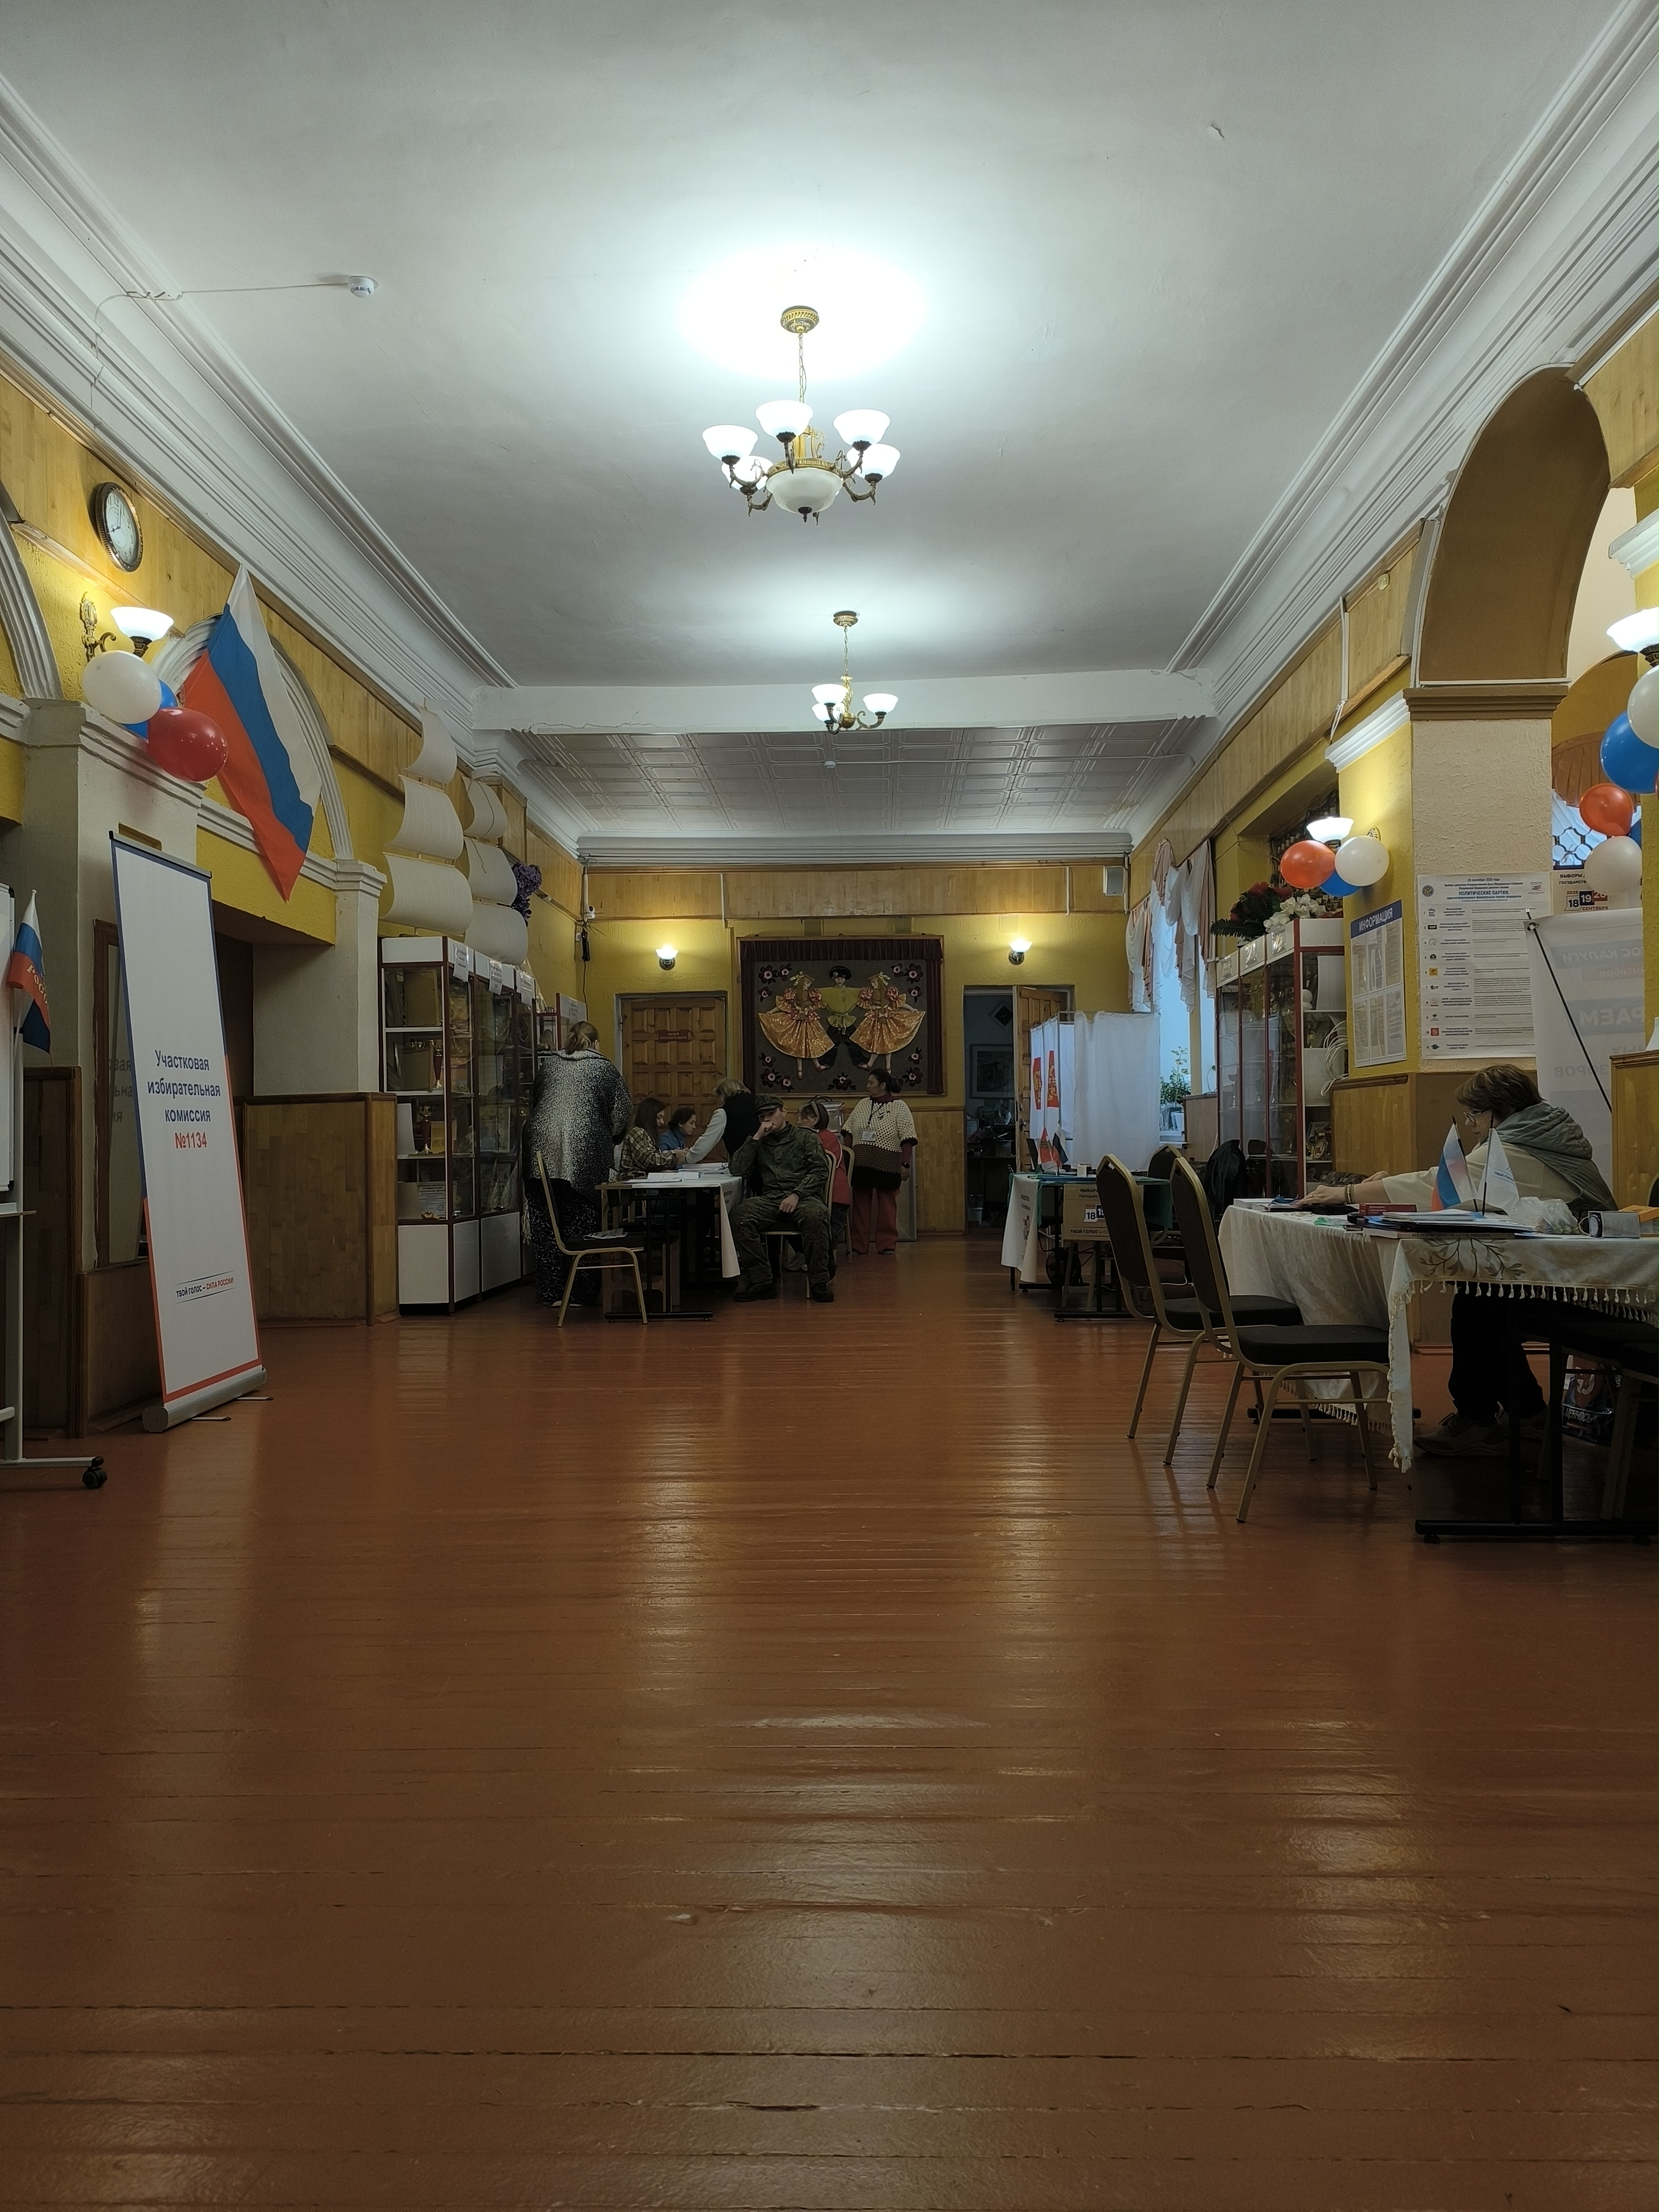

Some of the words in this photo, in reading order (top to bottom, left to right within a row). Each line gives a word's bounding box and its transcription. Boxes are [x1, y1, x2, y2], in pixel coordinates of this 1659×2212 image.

[1568, 899, 1579, 908] 18
[1580, 895, 1592, 903] 19
[1359, 908, 1393, 932] ИНФОРМАЦИЯ
[155, 1050, 209, 1071] Участковая
[147, 1077, 221, 1099] избирательная
[165, 1109, 211, 1122] комиссия
[175, 1131, 207, 1149] №1134
[1086, 1212, 1096, 1220] 18
[176, 1287, 188, 1298] ТВОЙ
[188, 1285, 202, 1295] ГОЛОС
[206, 1281, 218, 1290] СИЛА
[1565, 1407, 1592, 1423] ЦЕННОСТЬ
